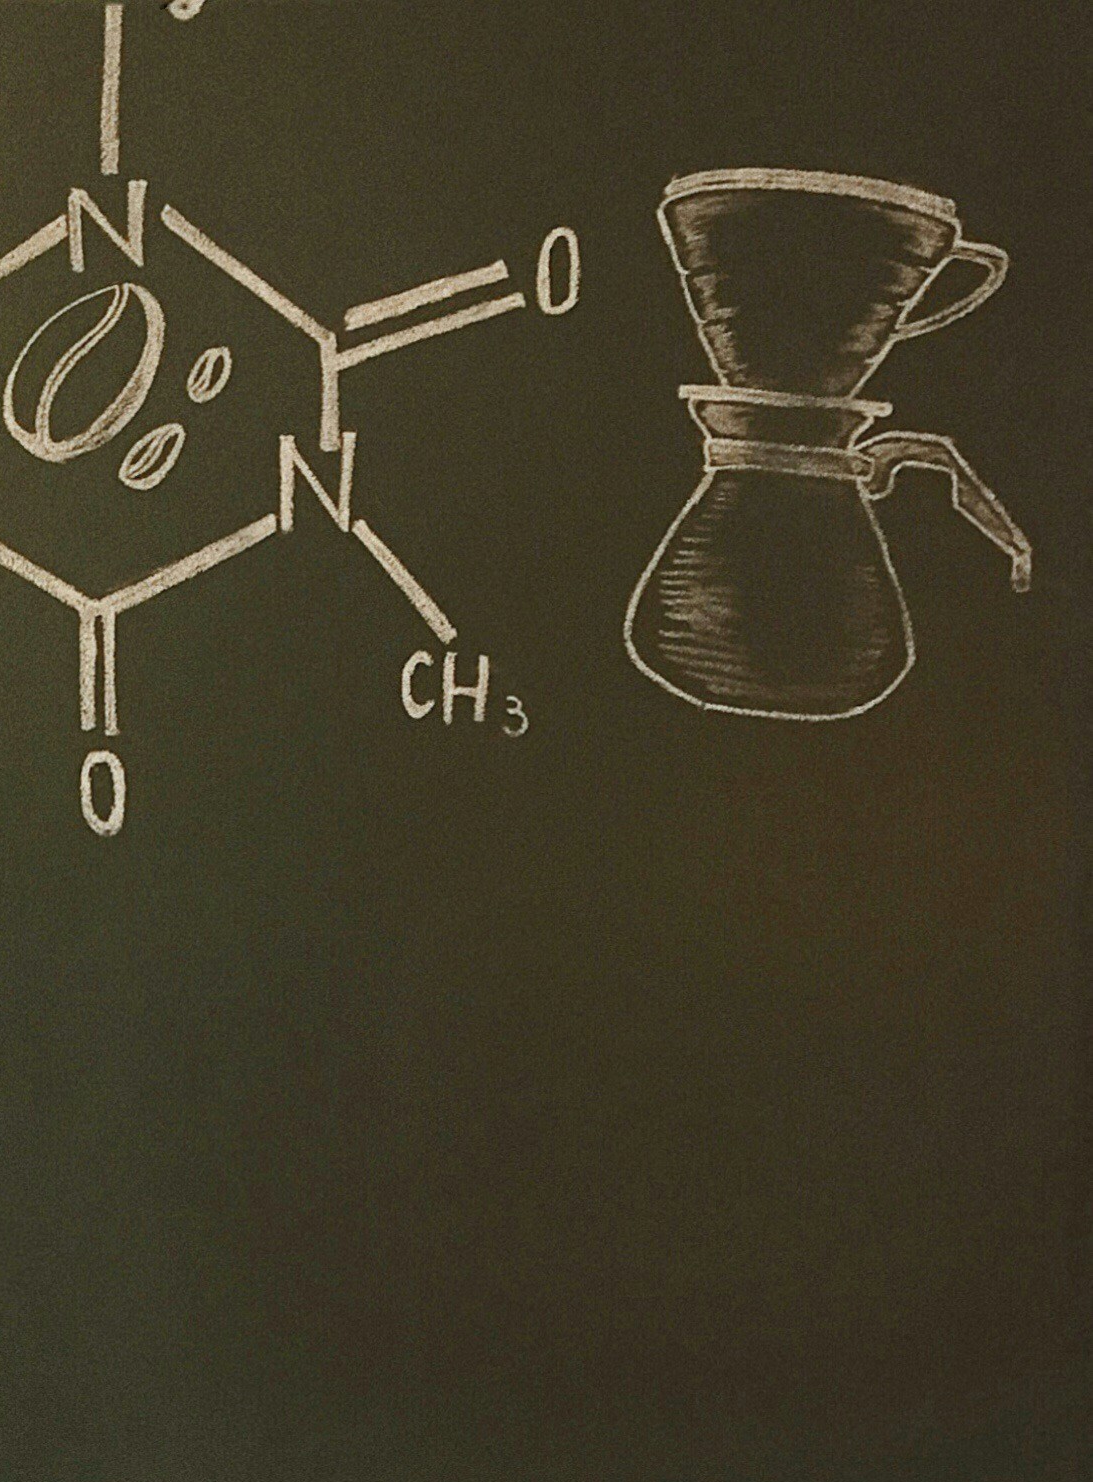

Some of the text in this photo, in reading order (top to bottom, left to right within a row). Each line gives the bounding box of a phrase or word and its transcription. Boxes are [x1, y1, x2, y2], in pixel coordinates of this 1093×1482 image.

[69, 178, 148, 273] N
[536, 226, 581, 315] O
[279, 431, 356, 533] N
[80, 750, 126, 836] O
